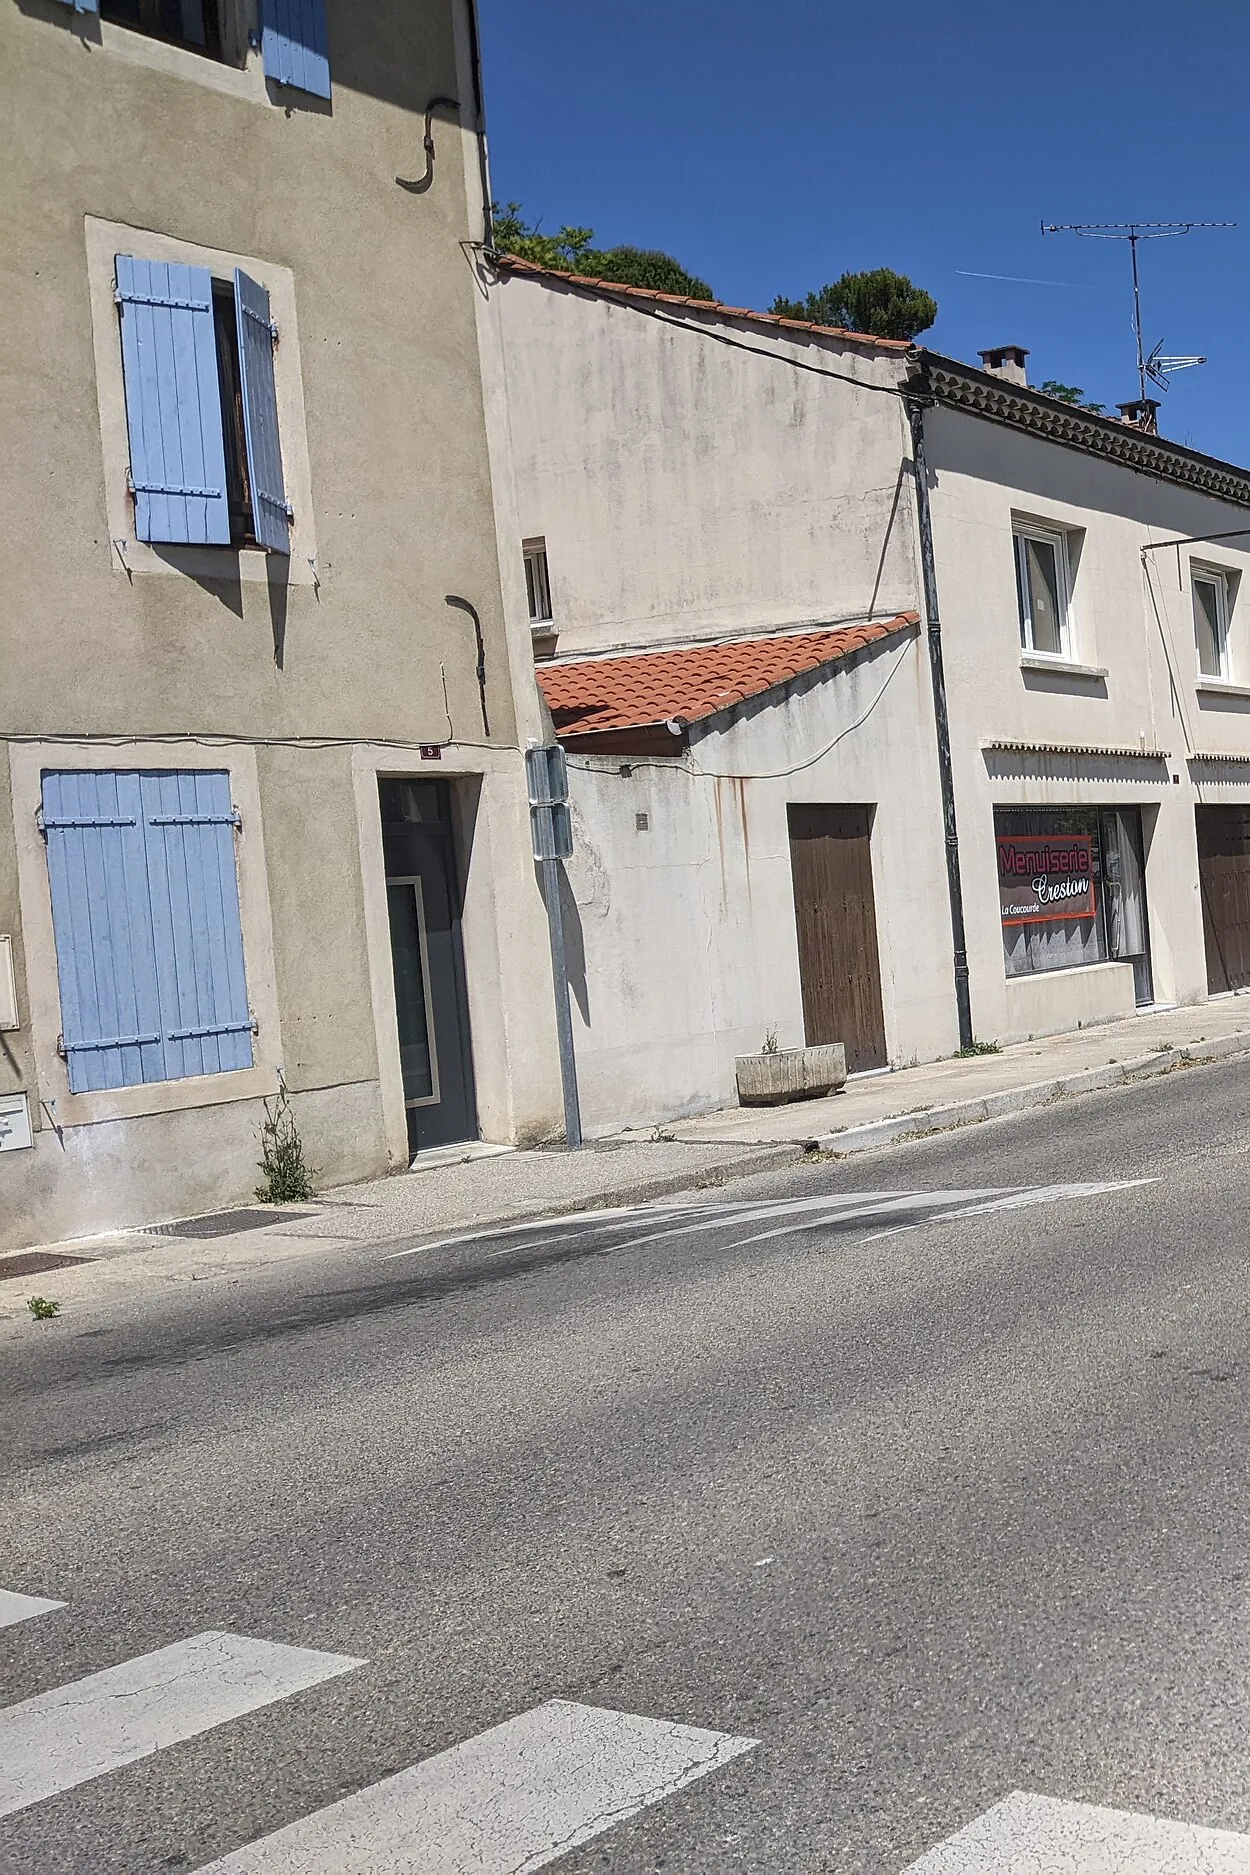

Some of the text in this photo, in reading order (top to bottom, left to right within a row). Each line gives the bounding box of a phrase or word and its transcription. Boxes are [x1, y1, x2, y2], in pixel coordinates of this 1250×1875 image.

[427, 747, 434, 756] 5
[998, 843, 1089, 877] Menuiserie
[1031, 873, 1090, 904] Creston
[1001, 902, 1040, 915] La Coucourde
